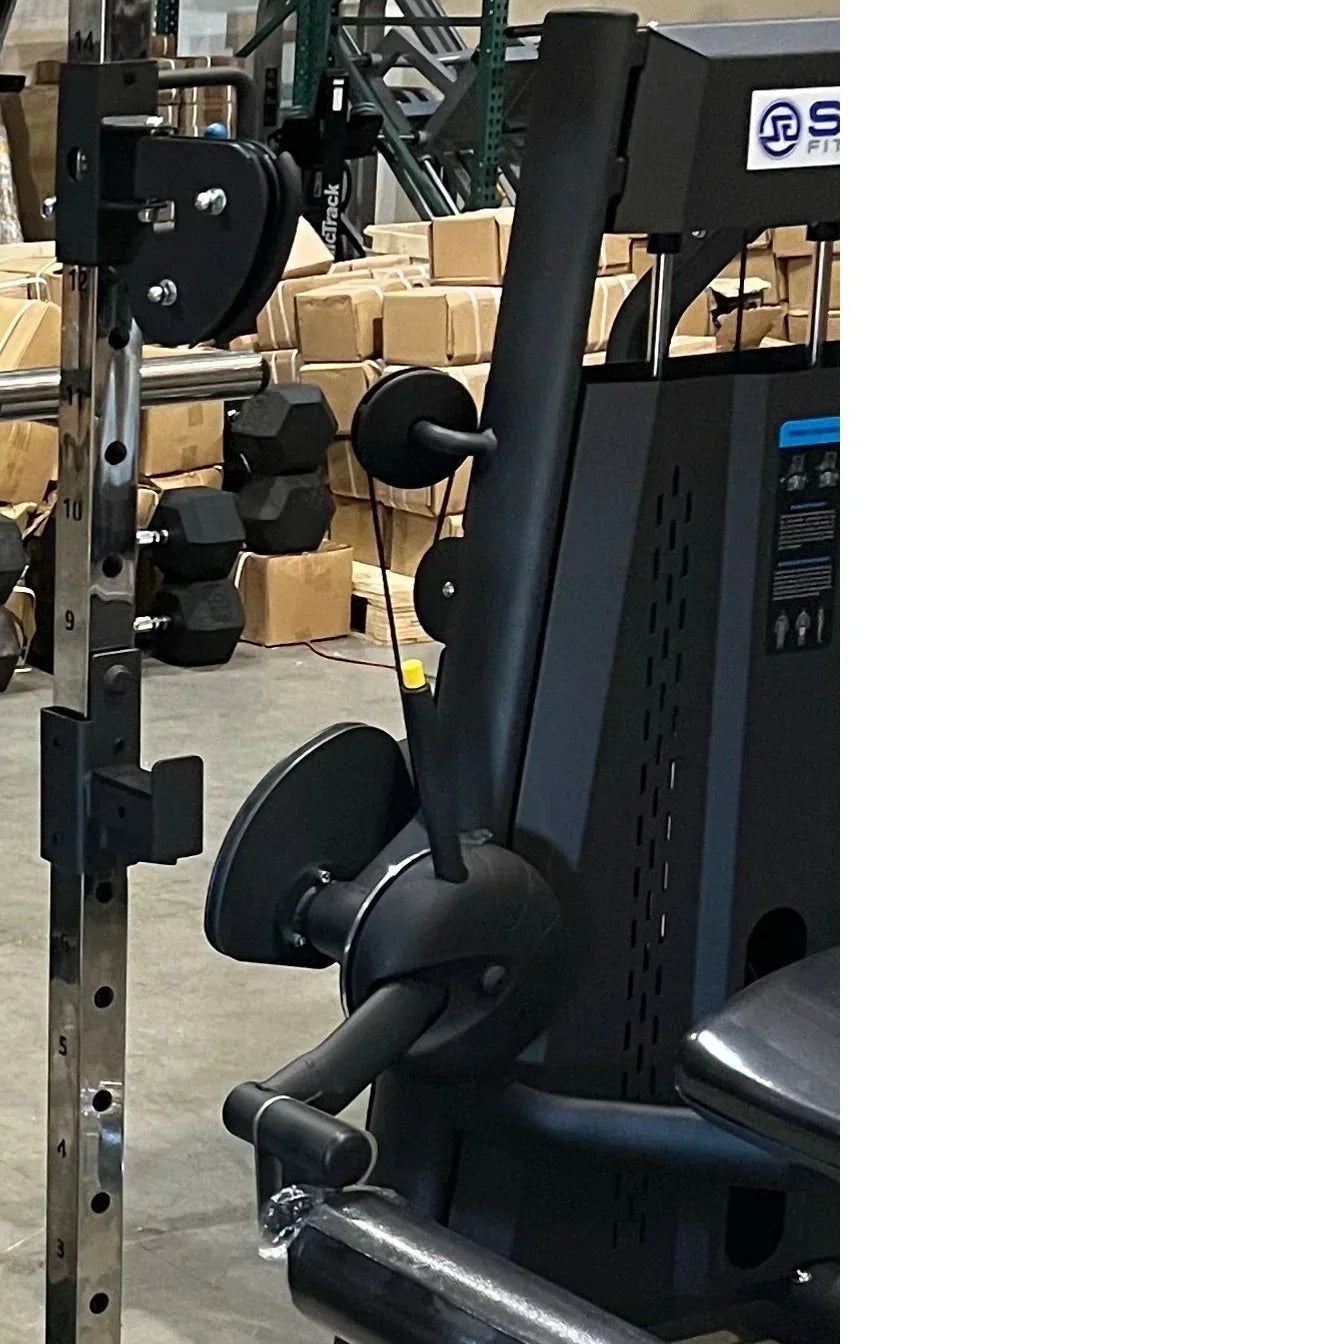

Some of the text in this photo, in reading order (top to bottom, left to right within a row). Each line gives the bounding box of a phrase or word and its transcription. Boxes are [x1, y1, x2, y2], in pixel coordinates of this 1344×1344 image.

[74, 29, 94, 53] 14
[68, 268, 88, 293] 12
[66, 383, 85, 406] 11
[63, 498, 83, 522] 10
[64, 609, 76, 632] 9
[58, 1034, 69, 1057] 5
